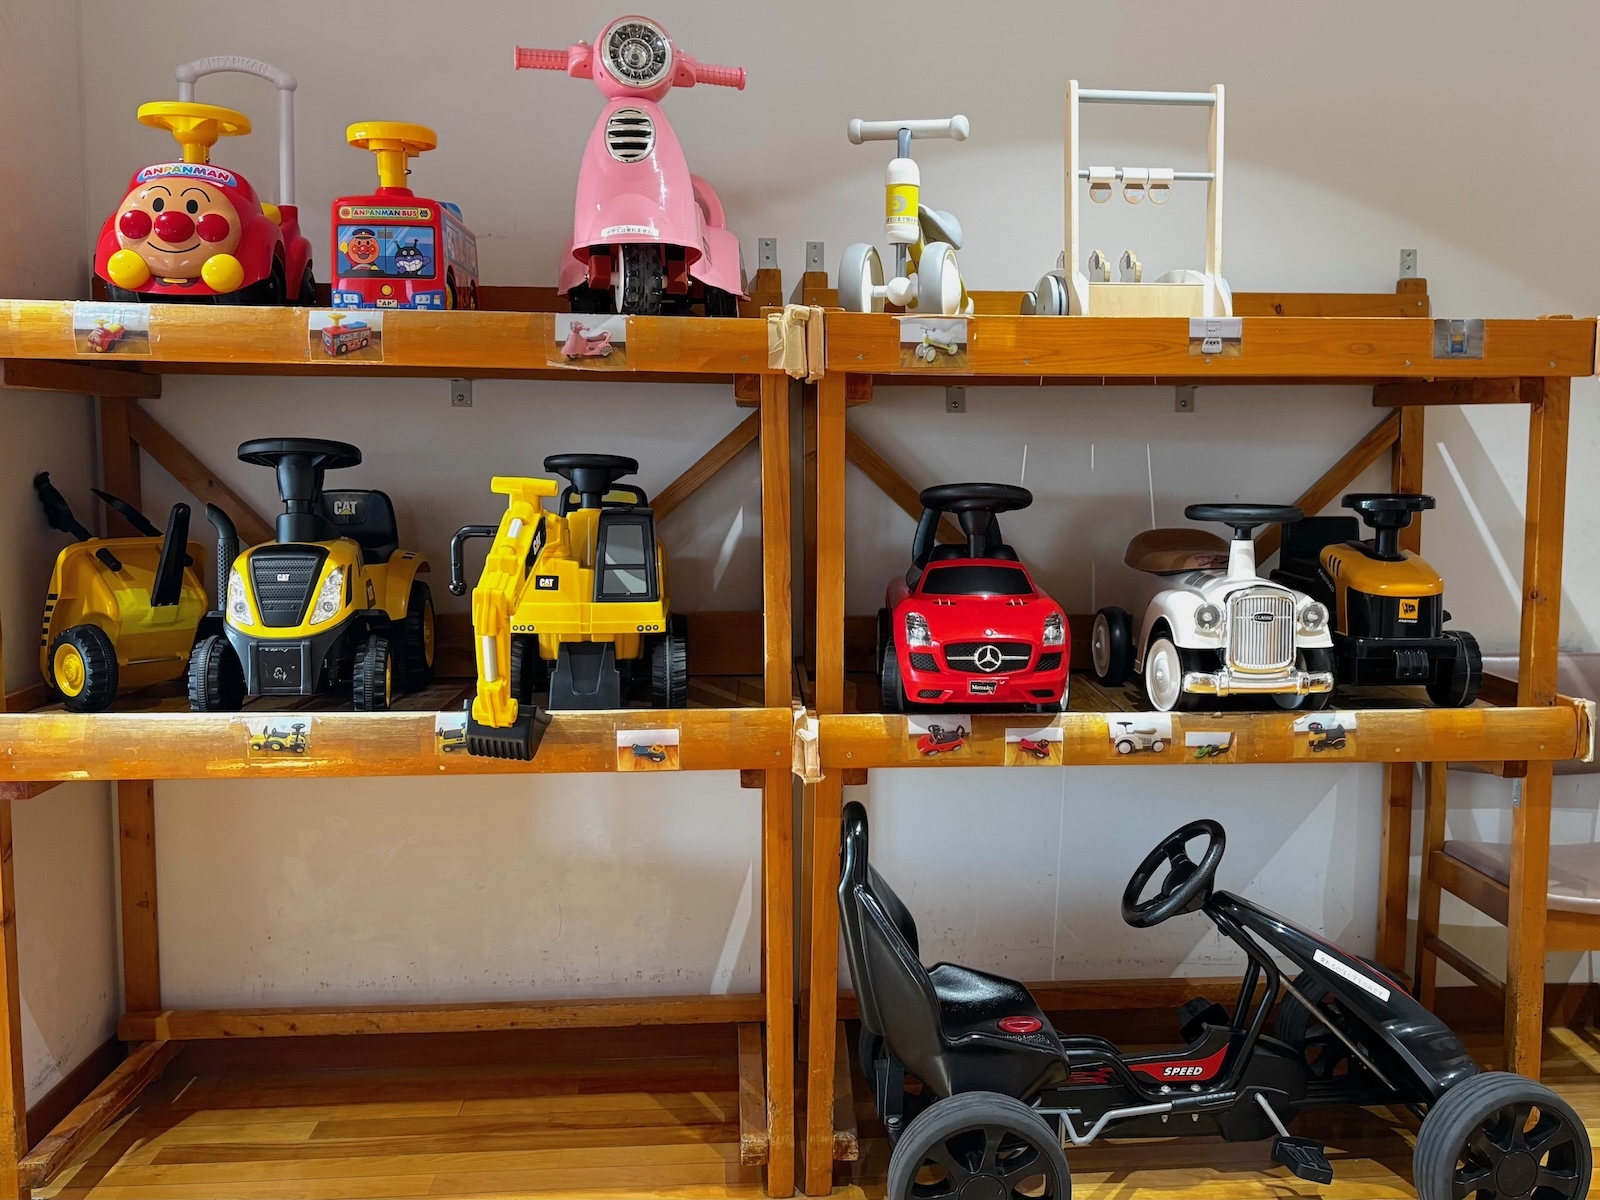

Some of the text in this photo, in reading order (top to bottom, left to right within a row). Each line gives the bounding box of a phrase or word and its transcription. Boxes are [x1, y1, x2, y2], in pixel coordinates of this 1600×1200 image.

[143, 166, 230, 181] ANPANMAN
[353, 209, 417, 217] ANPANMAN BUS
[333, 501, 358, 515] CAT
[276, 573, 290, 582] CAT
[539, 578, 554, 588] CAT
[1163, 1066, 1203, 1076] SPEED
